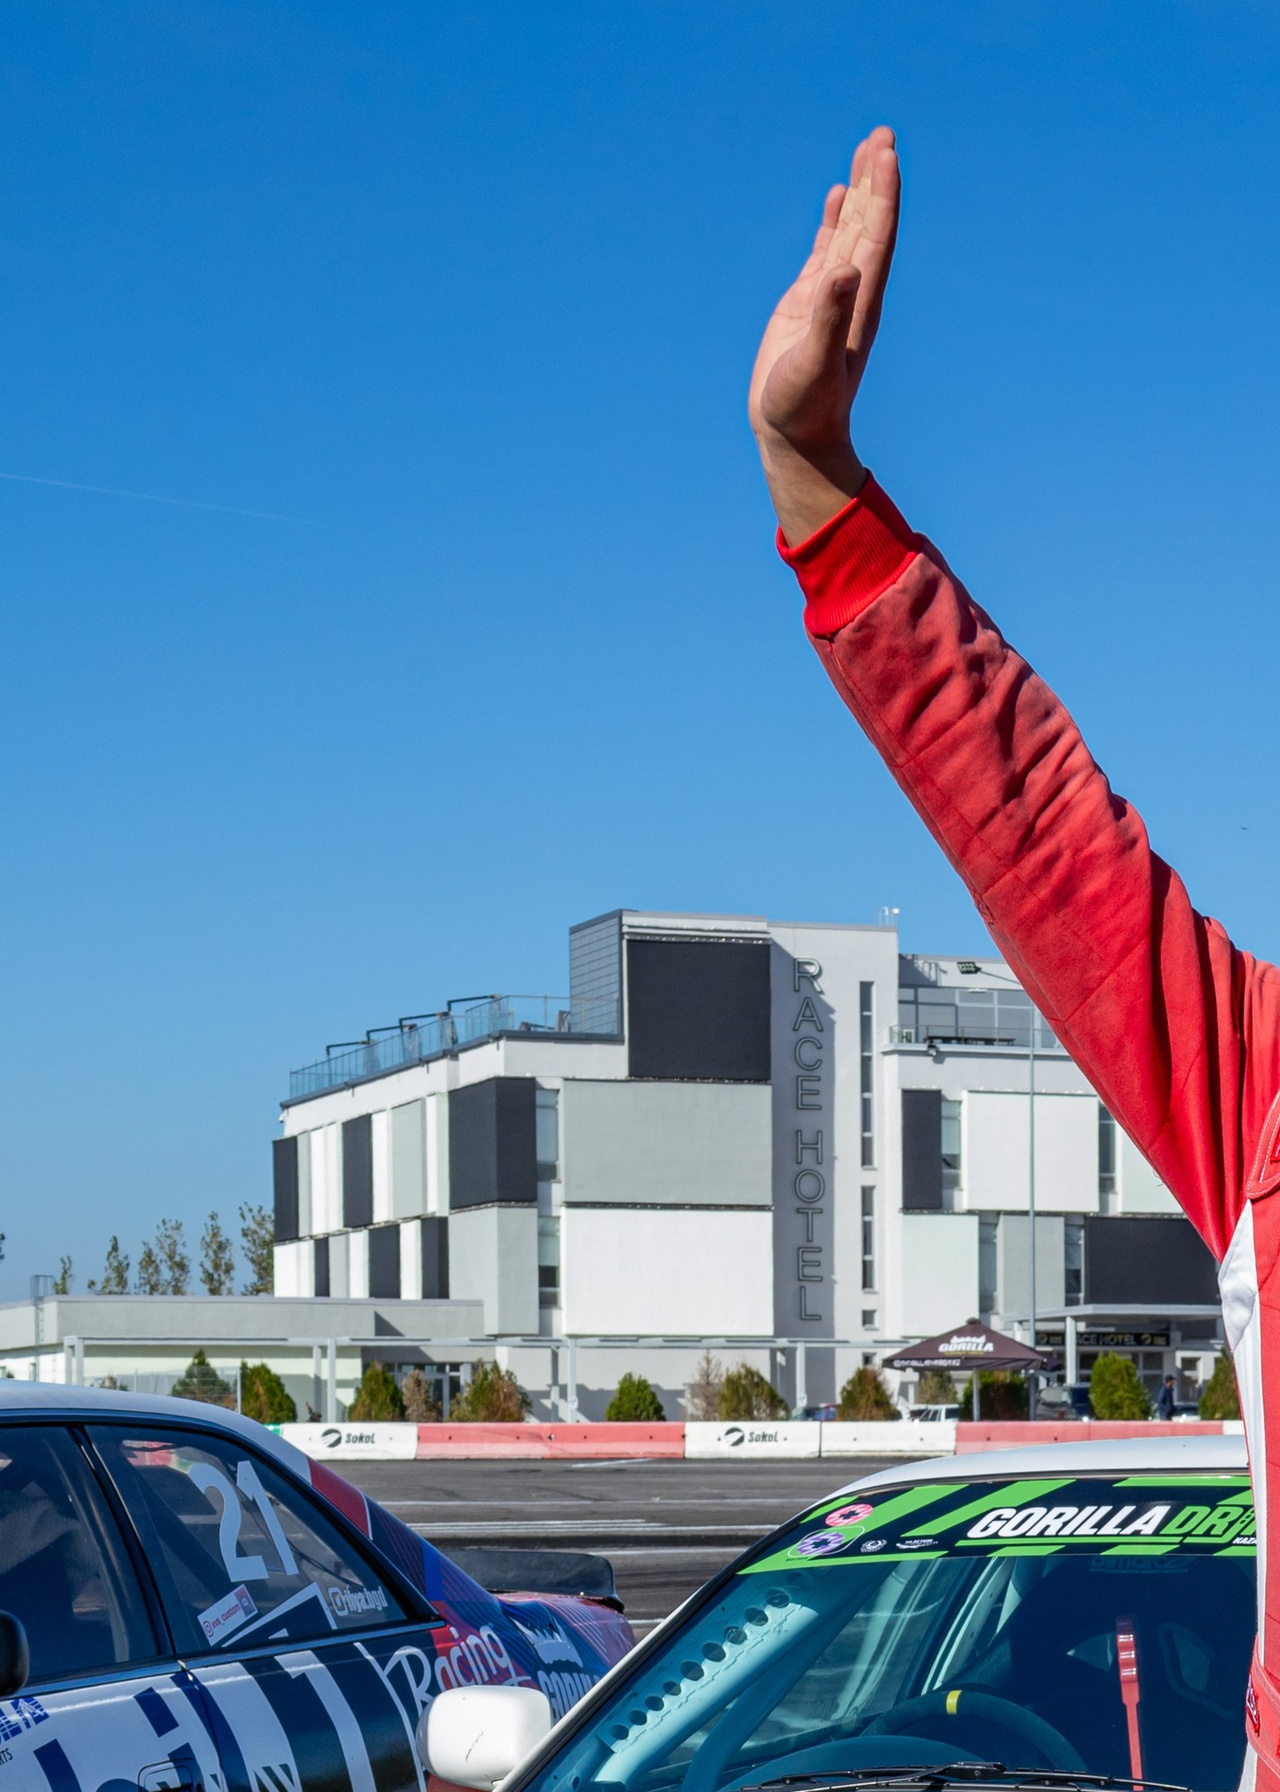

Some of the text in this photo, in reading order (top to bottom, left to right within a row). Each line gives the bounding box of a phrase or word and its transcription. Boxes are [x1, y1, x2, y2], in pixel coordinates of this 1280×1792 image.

[792, 957, 826, 1322] RACE HOTEL
[938, 1342, 994, 1352] GORILLA
[345, 1432, 376, 1444] Sokol
[748, 1430, 779, 1443] Sokol
[188, 1460, 299, 1583] 21
[966, 1504, 1172, 1538] GORILLA
